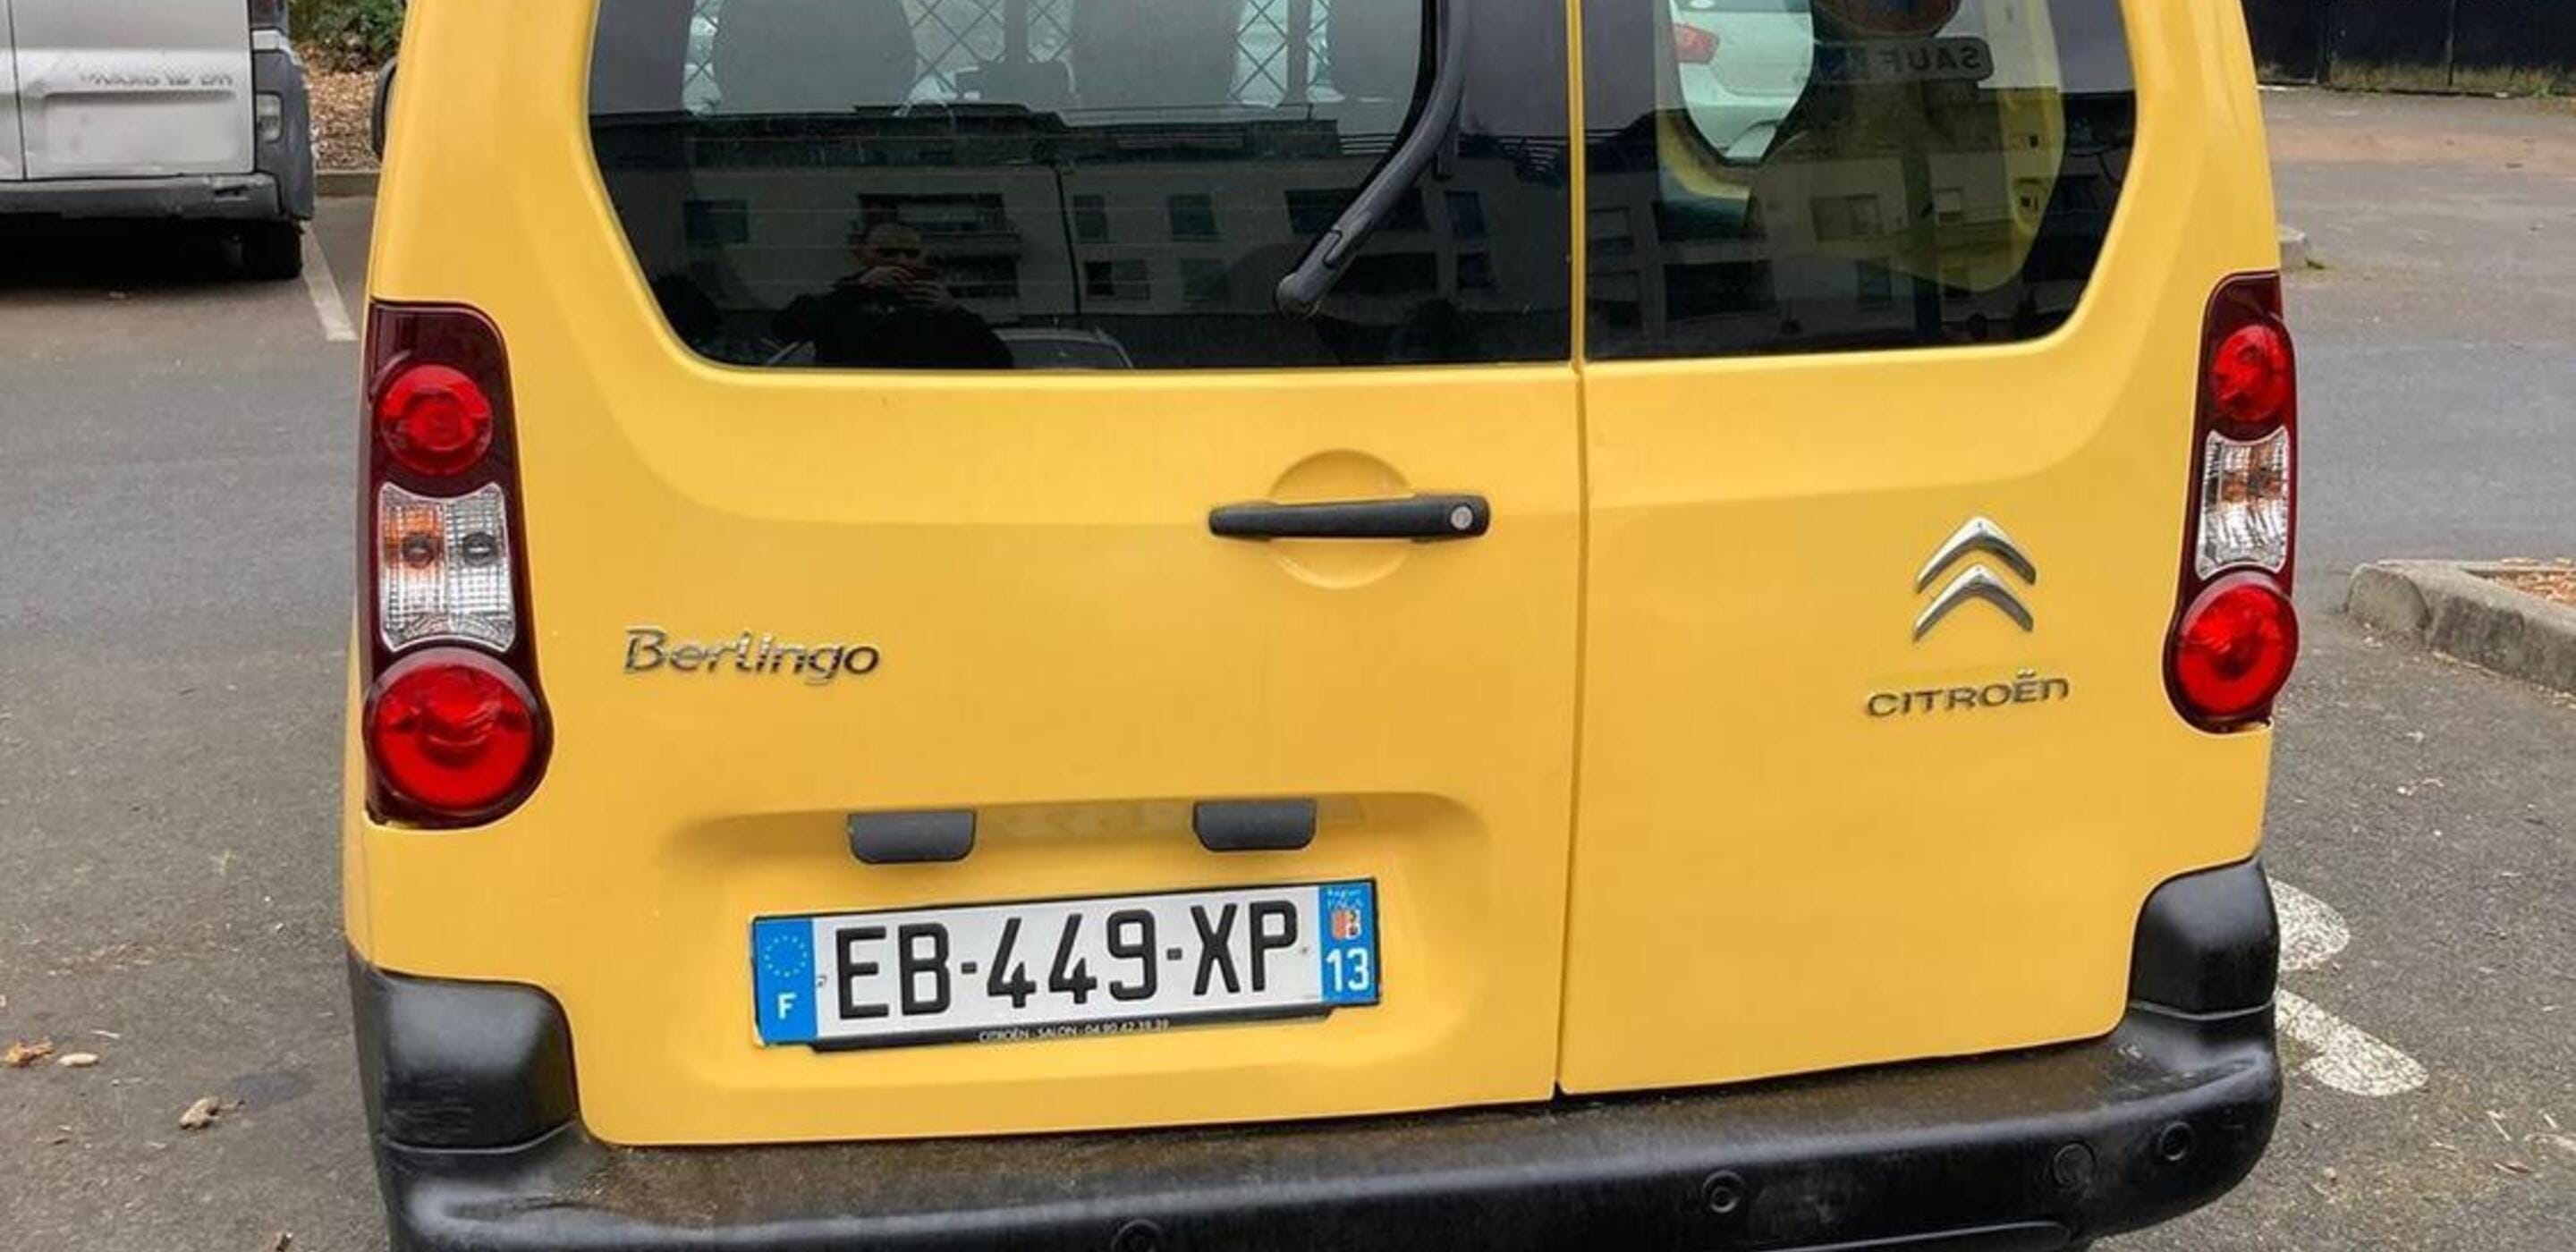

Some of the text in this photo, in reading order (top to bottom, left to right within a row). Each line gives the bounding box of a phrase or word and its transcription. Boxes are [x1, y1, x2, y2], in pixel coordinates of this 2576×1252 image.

[624, 626, 880, 685] Berlingo
[835, 900, 1298, 1019] EB-449-XP
[1327, 946, 1370, 992] 13
[777, 992, 797, 1020] F
